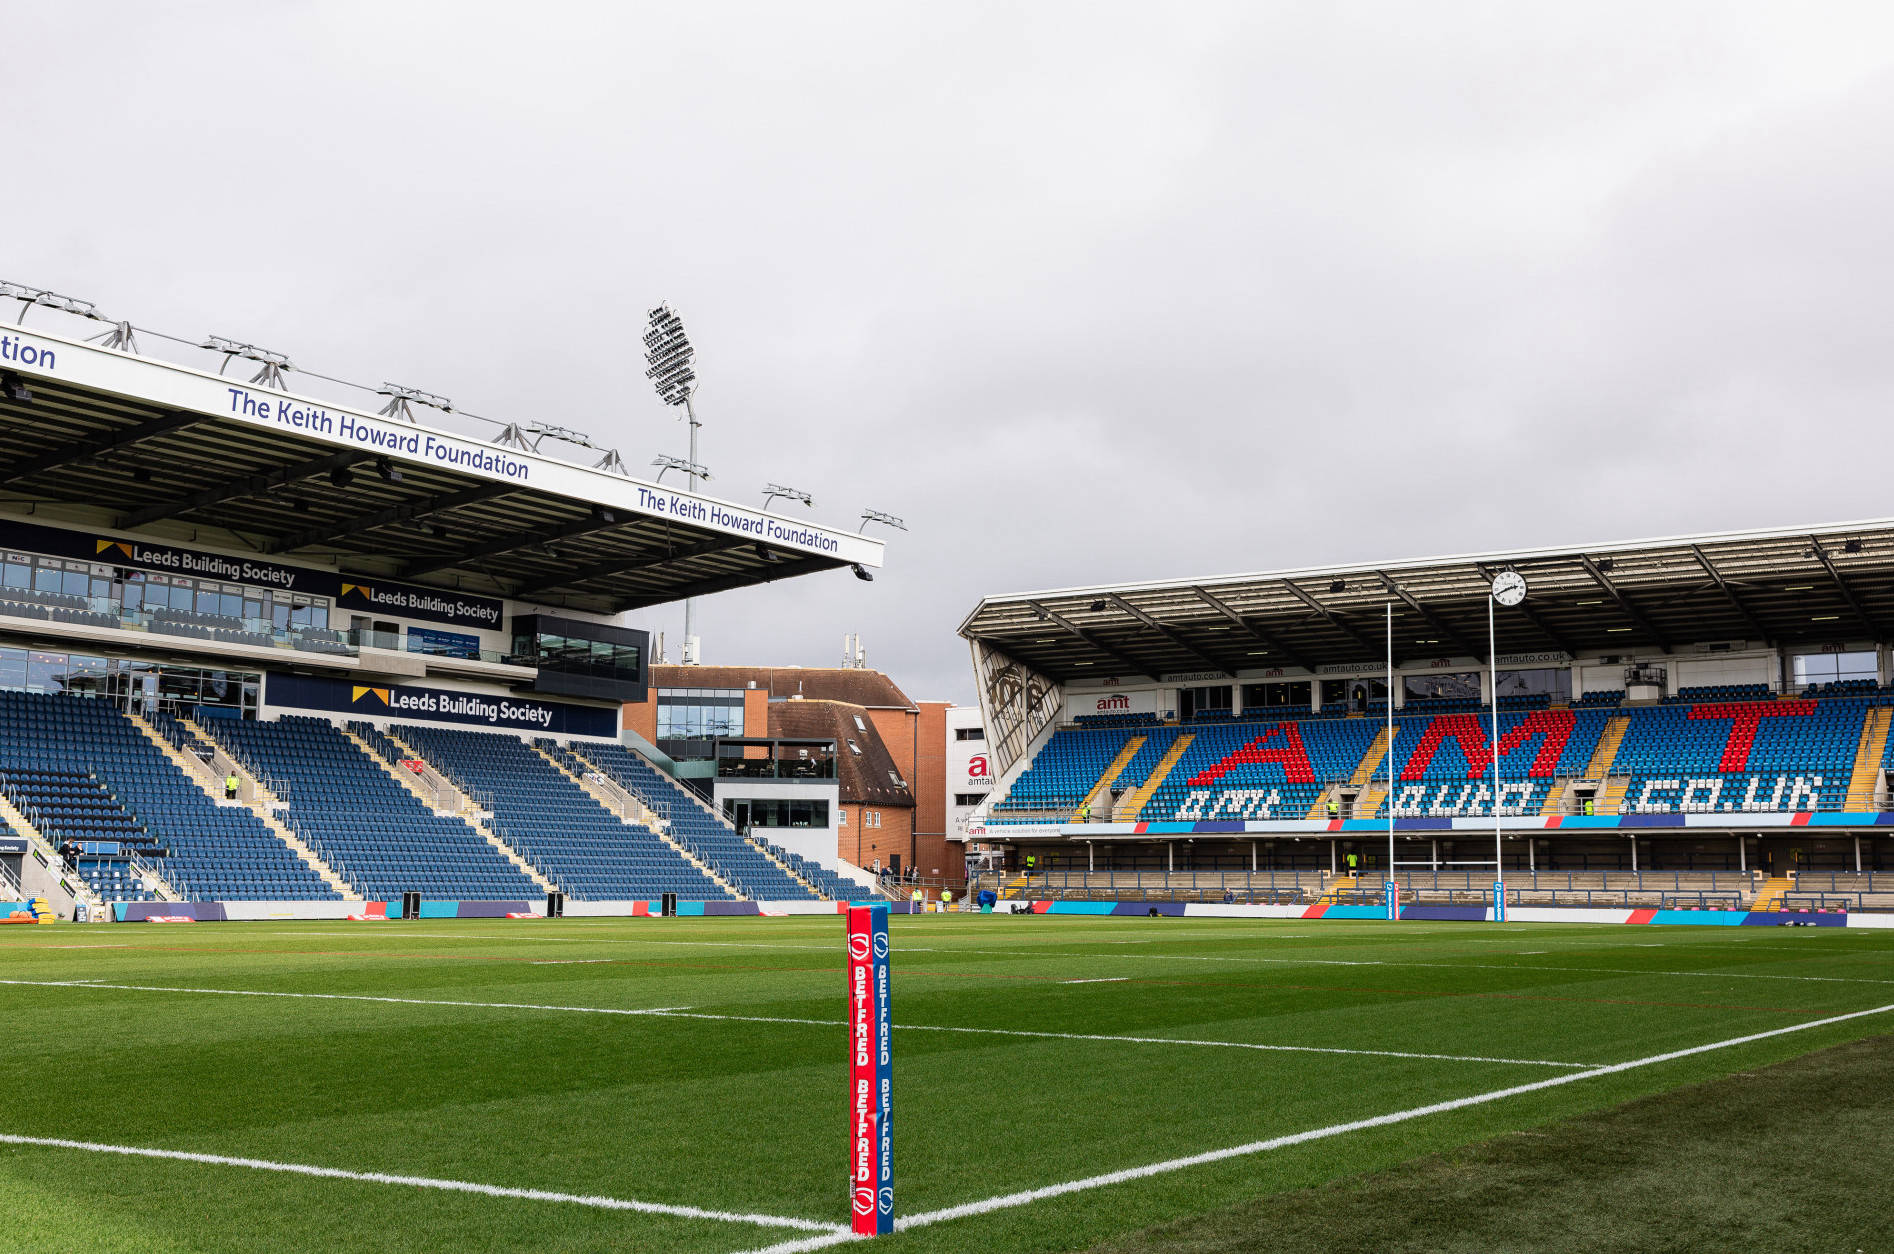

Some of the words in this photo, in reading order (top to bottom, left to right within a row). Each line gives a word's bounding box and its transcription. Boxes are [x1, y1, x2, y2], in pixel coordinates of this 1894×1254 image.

[228, 388, 270, 419] The
[277, 400, 333, 434] Keith
[340, 415, 419, 454] Howard
[425, 437, 529, 479] Foundation
[638, 487, 666, 512] The
[669, 496, 706, 521] Keith
[710, 504, 763, 534] Howard
[767, 520, 838, 552] Foundation
[133, 546, 179, 569] Leeds
[182, 552, 240, 581] Building
[243, 562, 295, 588] Society
[370, 589, 406, 607] Leeds
[409, 593, 454, 617] Building
[456, 600, 499, 623] Society
[1097, 697, 1129, 709] amt
[1167, 672, 1227, 682] amtauto.co.uk
[390, 689, 437, 711] Leeds
[440, 694, 497, 723] Building
[500, 701, 552, 727] Society
[969, 827, 986, 835] amt
[855, 966, 869, 1066] BETFRED
[879, 965, 888, 1066] BETFRED
[857, 1080, 870, 1182] BETFRED
[881, 1079, 890, 1181] BETFRED
